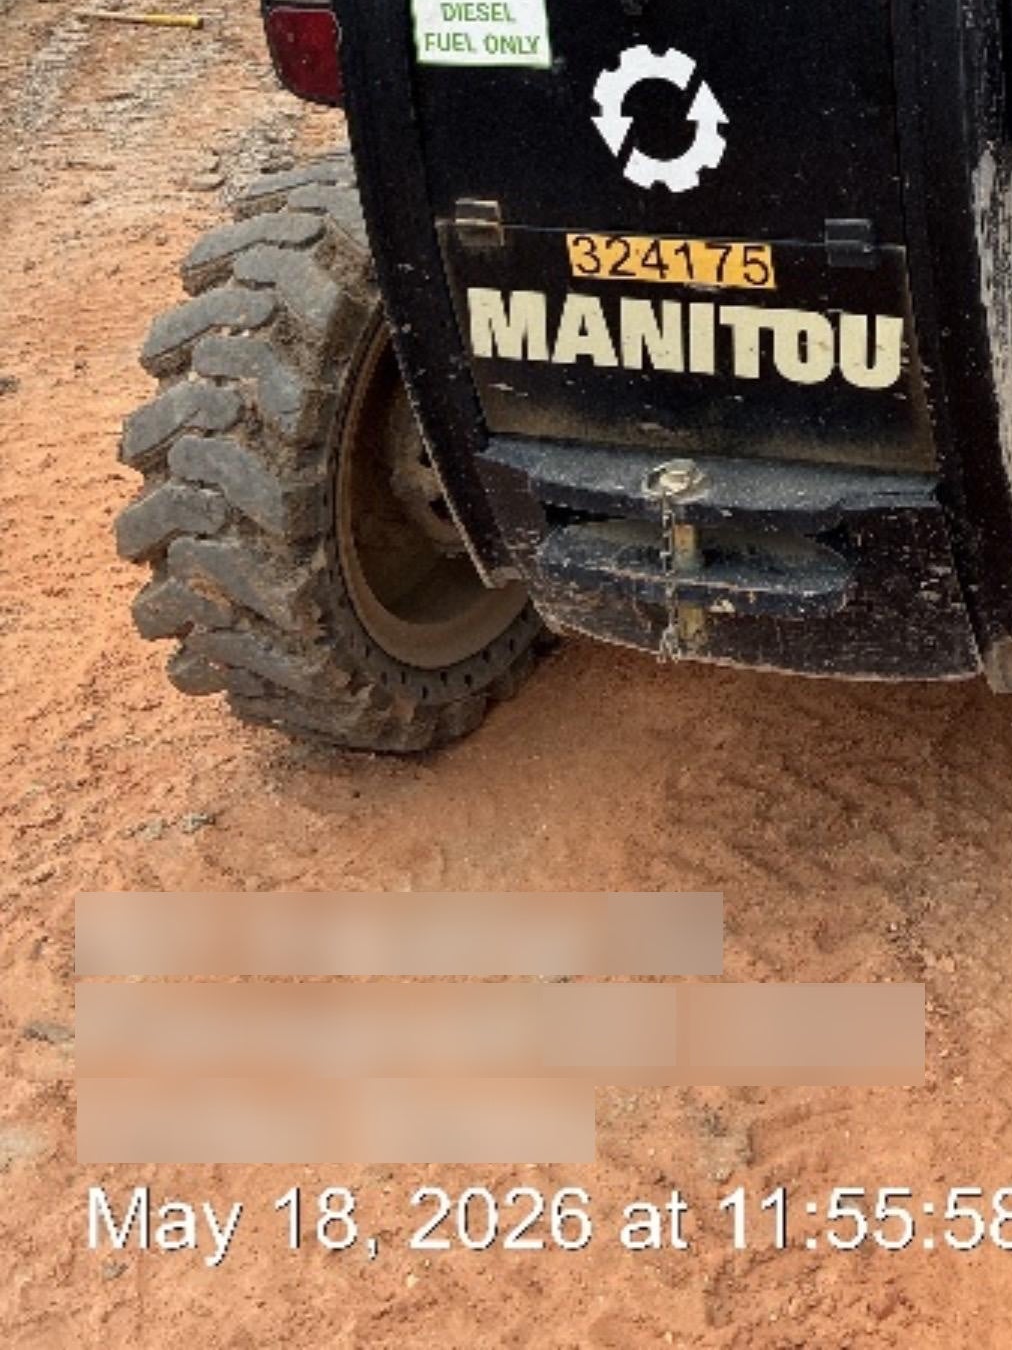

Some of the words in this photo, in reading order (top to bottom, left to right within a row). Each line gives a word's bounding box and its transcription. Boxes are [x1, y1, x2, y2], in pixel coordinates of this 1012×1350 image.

[439, 1, 518, 23] DIESEL
[423, 32, 476, 53] FUEL
[483, 33, 541, 55] ONLY
[572, 236, 770, 285] 324175
[467, 286, 904, 389] MANITOU
